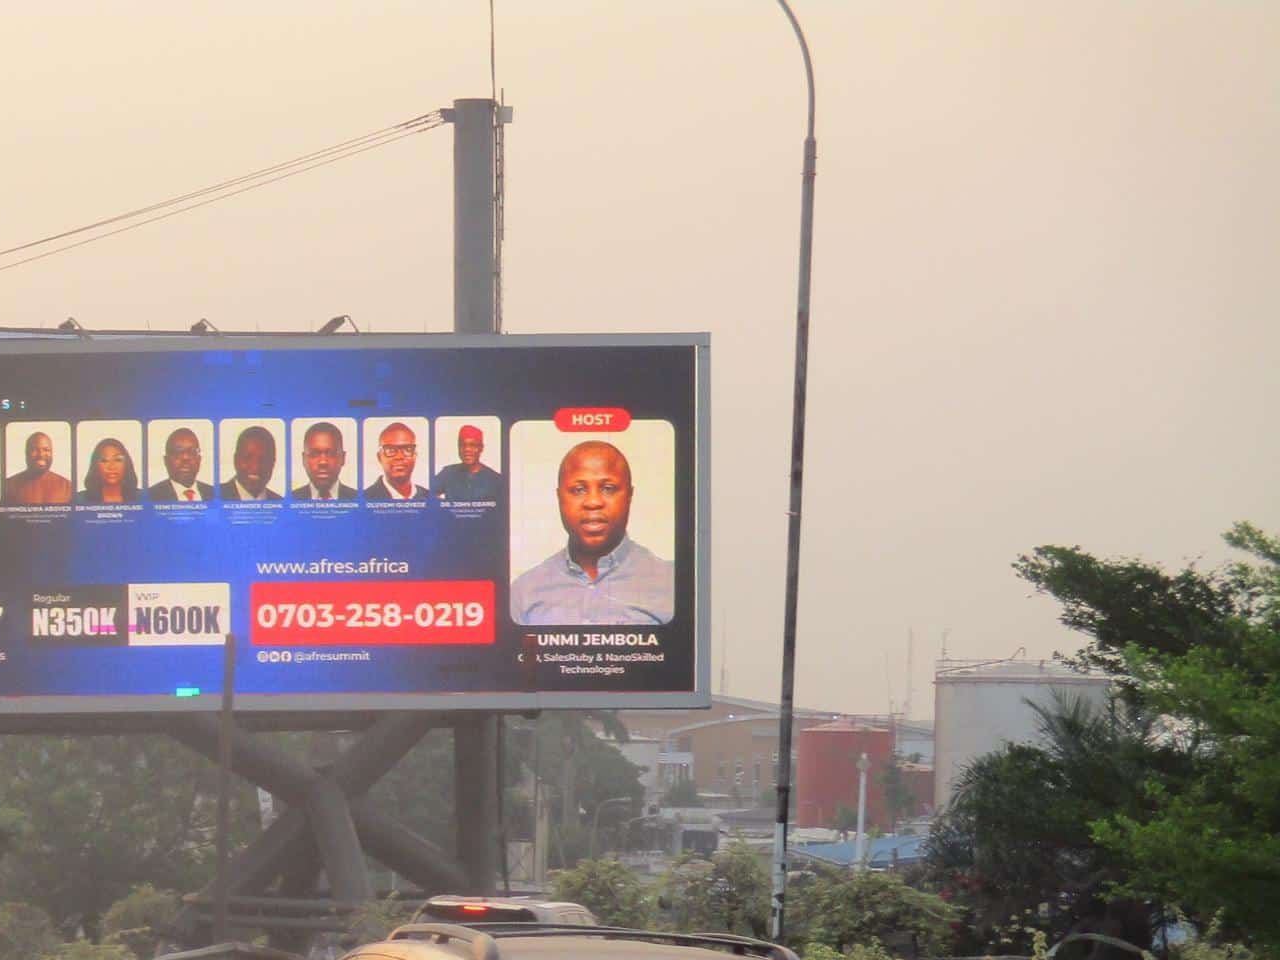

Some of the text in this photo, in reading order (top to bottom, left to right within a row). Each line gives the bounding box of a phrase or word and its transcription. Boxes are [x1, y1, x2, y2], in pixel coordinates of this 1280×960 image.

[571, 414, 613, 426] HOST
[256, 559, 409, 574] www.afres.africa
[33, 593, 71, 604] Regular
[135, 605, 220, 635] N600K
[257, 602, 484, 628] 0703-258-0219
[32, 607, 117, 636] N350K
[526, 633, 658, 646] UNMI JEMBOLA
[294, 651, 370, 663] @afresummit
[543, 653, 594, 664] SalesRuby
[596, 653, 604, 662] &
[605, 652, 664, 662] NanoSkilled
[560, 665, 624, 675] Technologies
